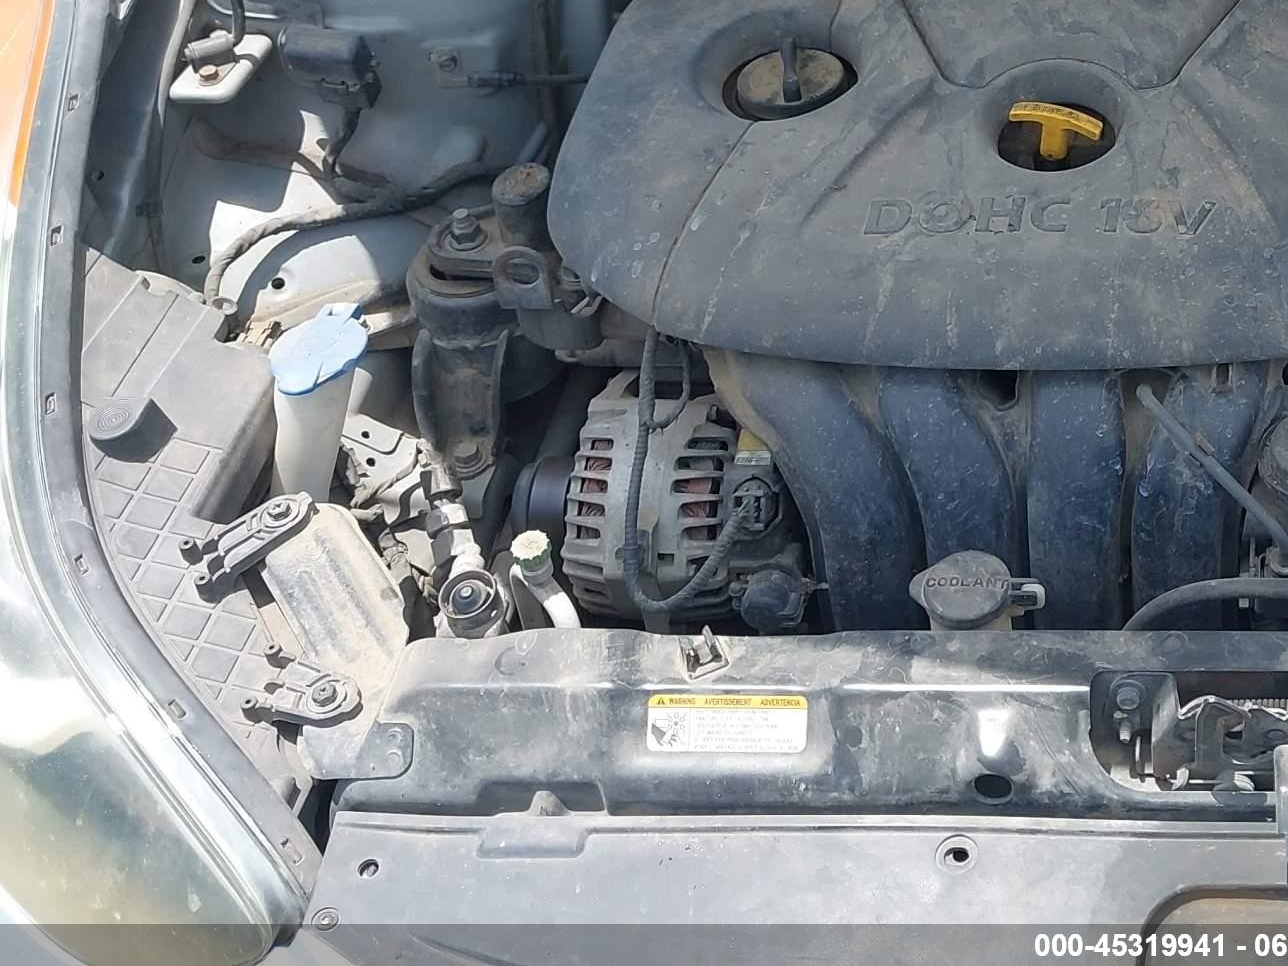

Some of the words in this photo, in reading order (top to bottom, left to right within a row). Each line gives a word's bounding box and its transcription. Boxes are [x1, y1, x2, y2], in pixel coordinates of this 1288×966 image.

[863, 195, 1071, 236] DOHC
[1099, 196, 1217, 236] 16V
[926, 576, 1009, 589] COOLANT
[668, 697, 696, 705] WARNING
[704, 698, 752, 706] AVERTISSEMENT
[760, 699, 801, 707] ADVERTENCIA
